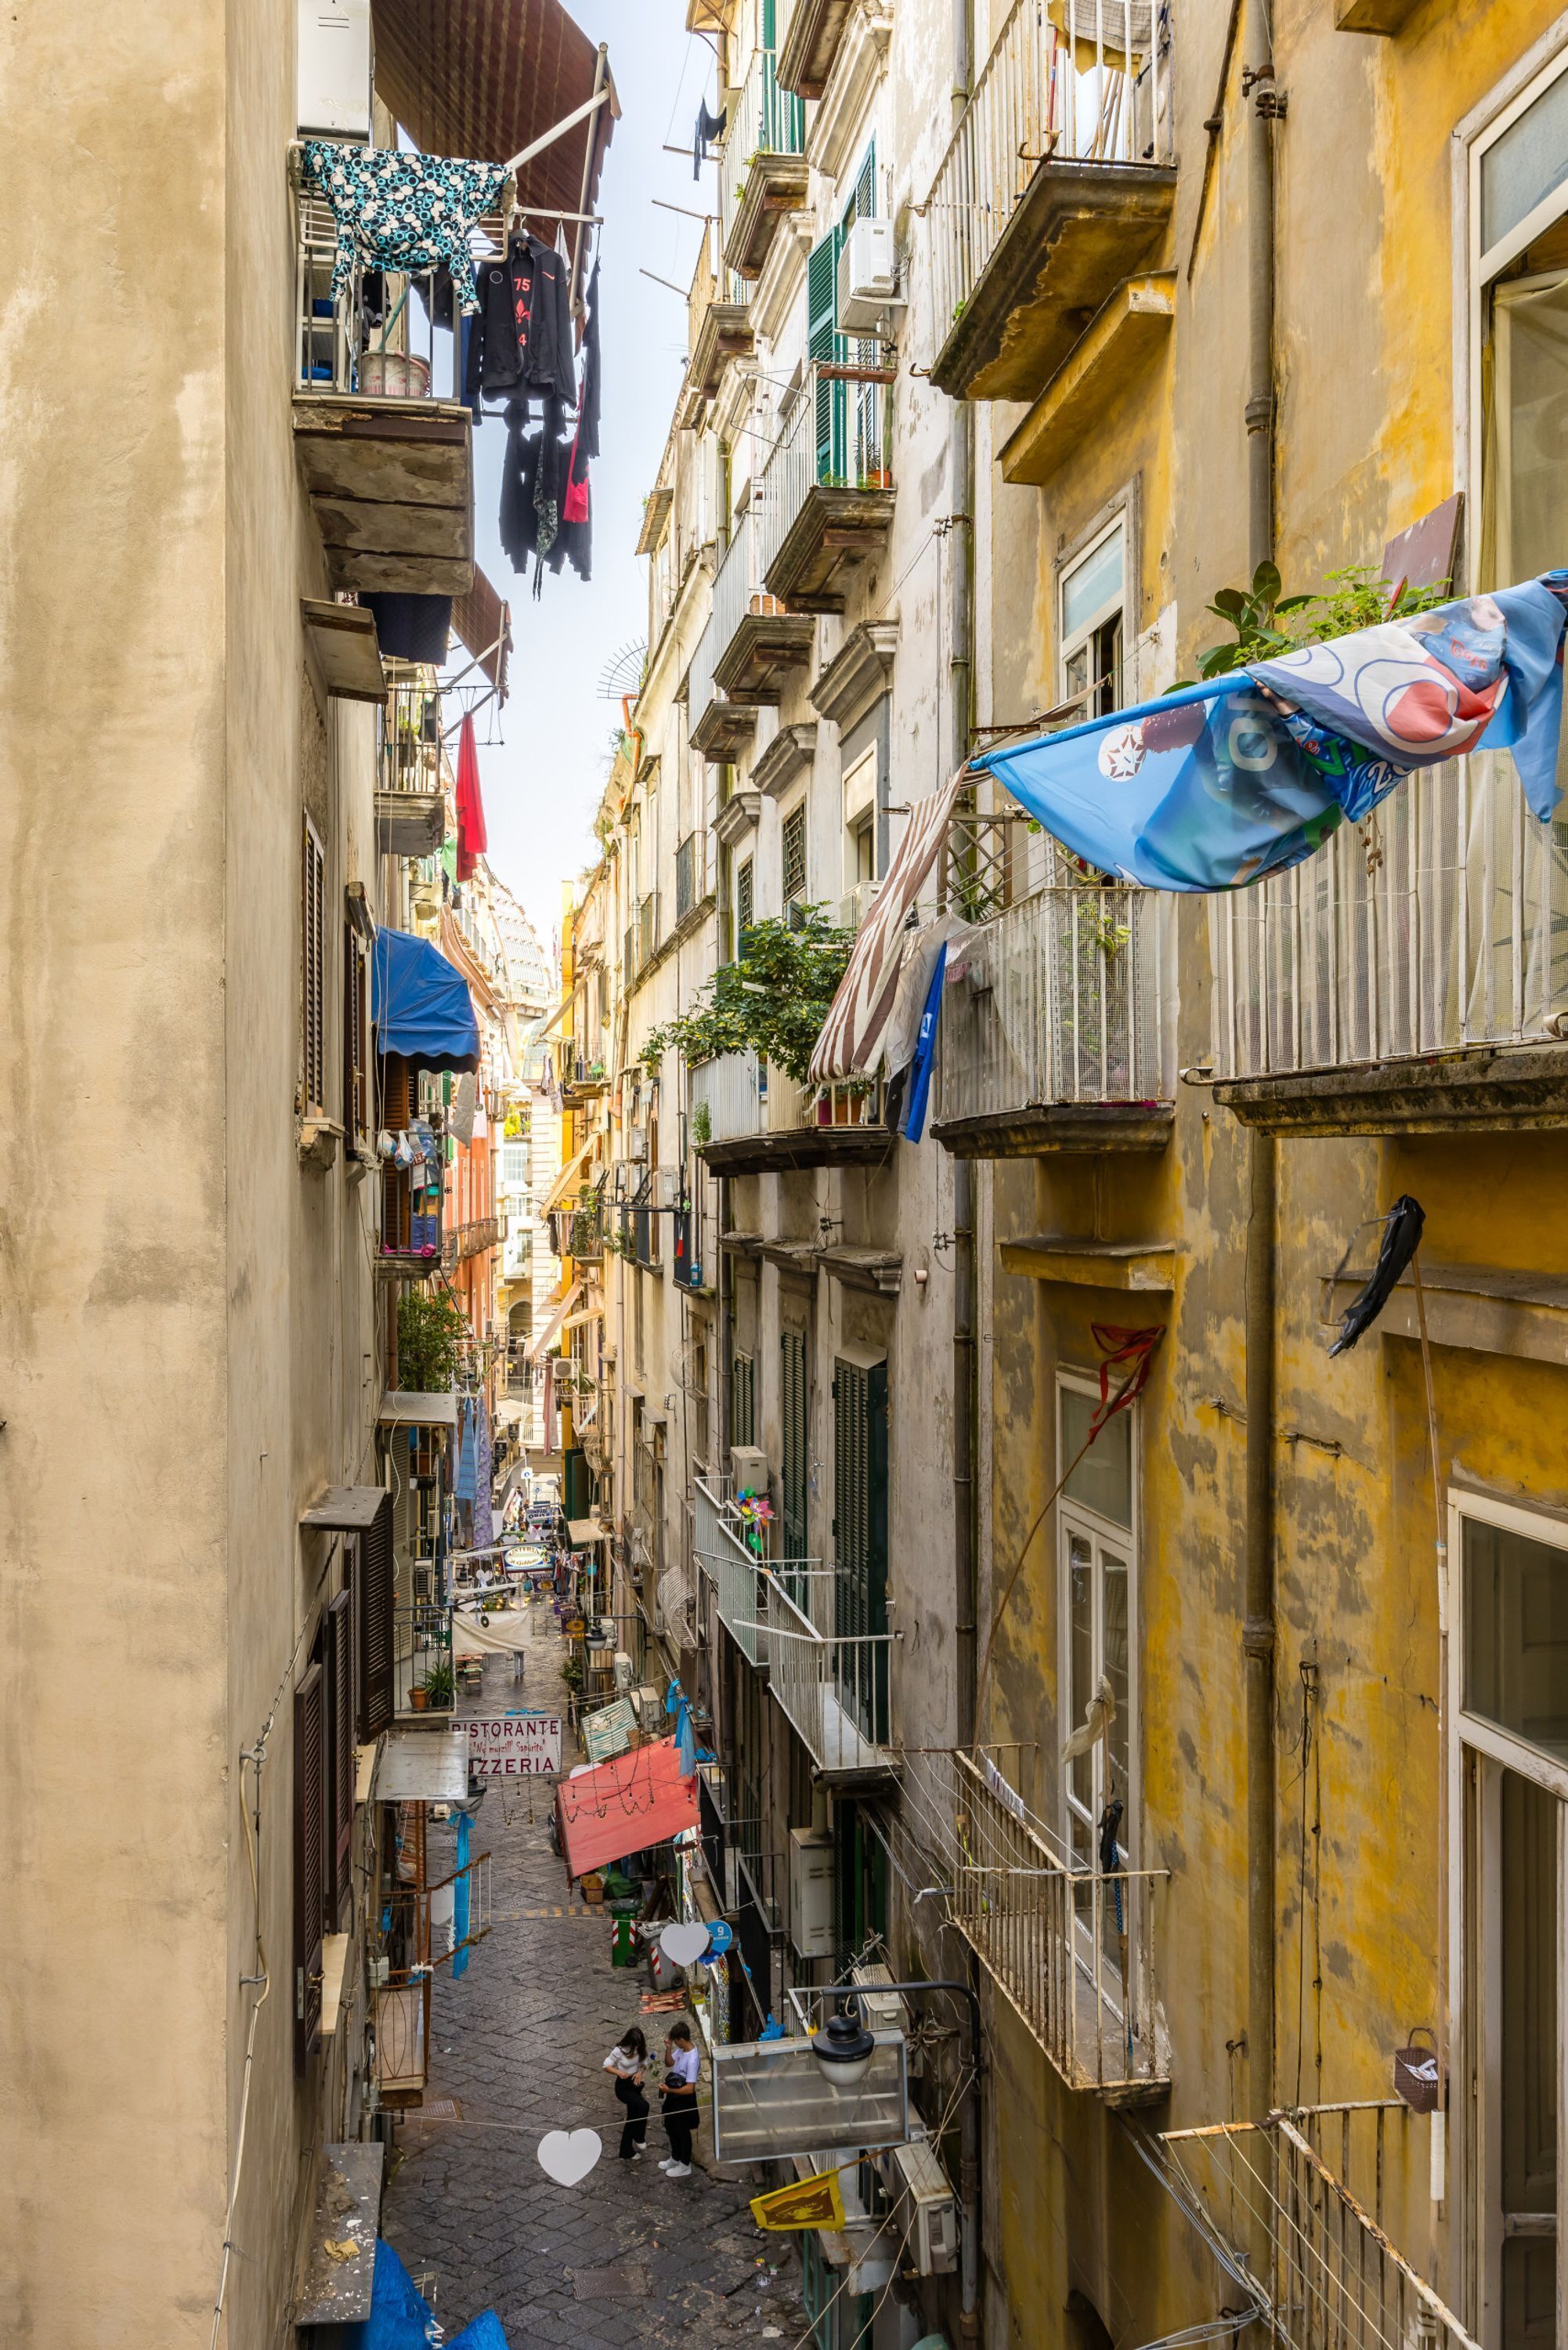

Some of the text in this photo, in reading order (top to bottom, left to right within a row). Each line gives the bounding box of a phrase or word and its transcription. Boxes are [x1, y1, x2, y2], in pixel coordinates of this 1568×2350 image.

[514, 277, 532, 291] 75
[518, 333, 527, 346] 4
[469, 1757, 555, 1774] IZZERIA
[717, 1926, 724, 1936] 9
